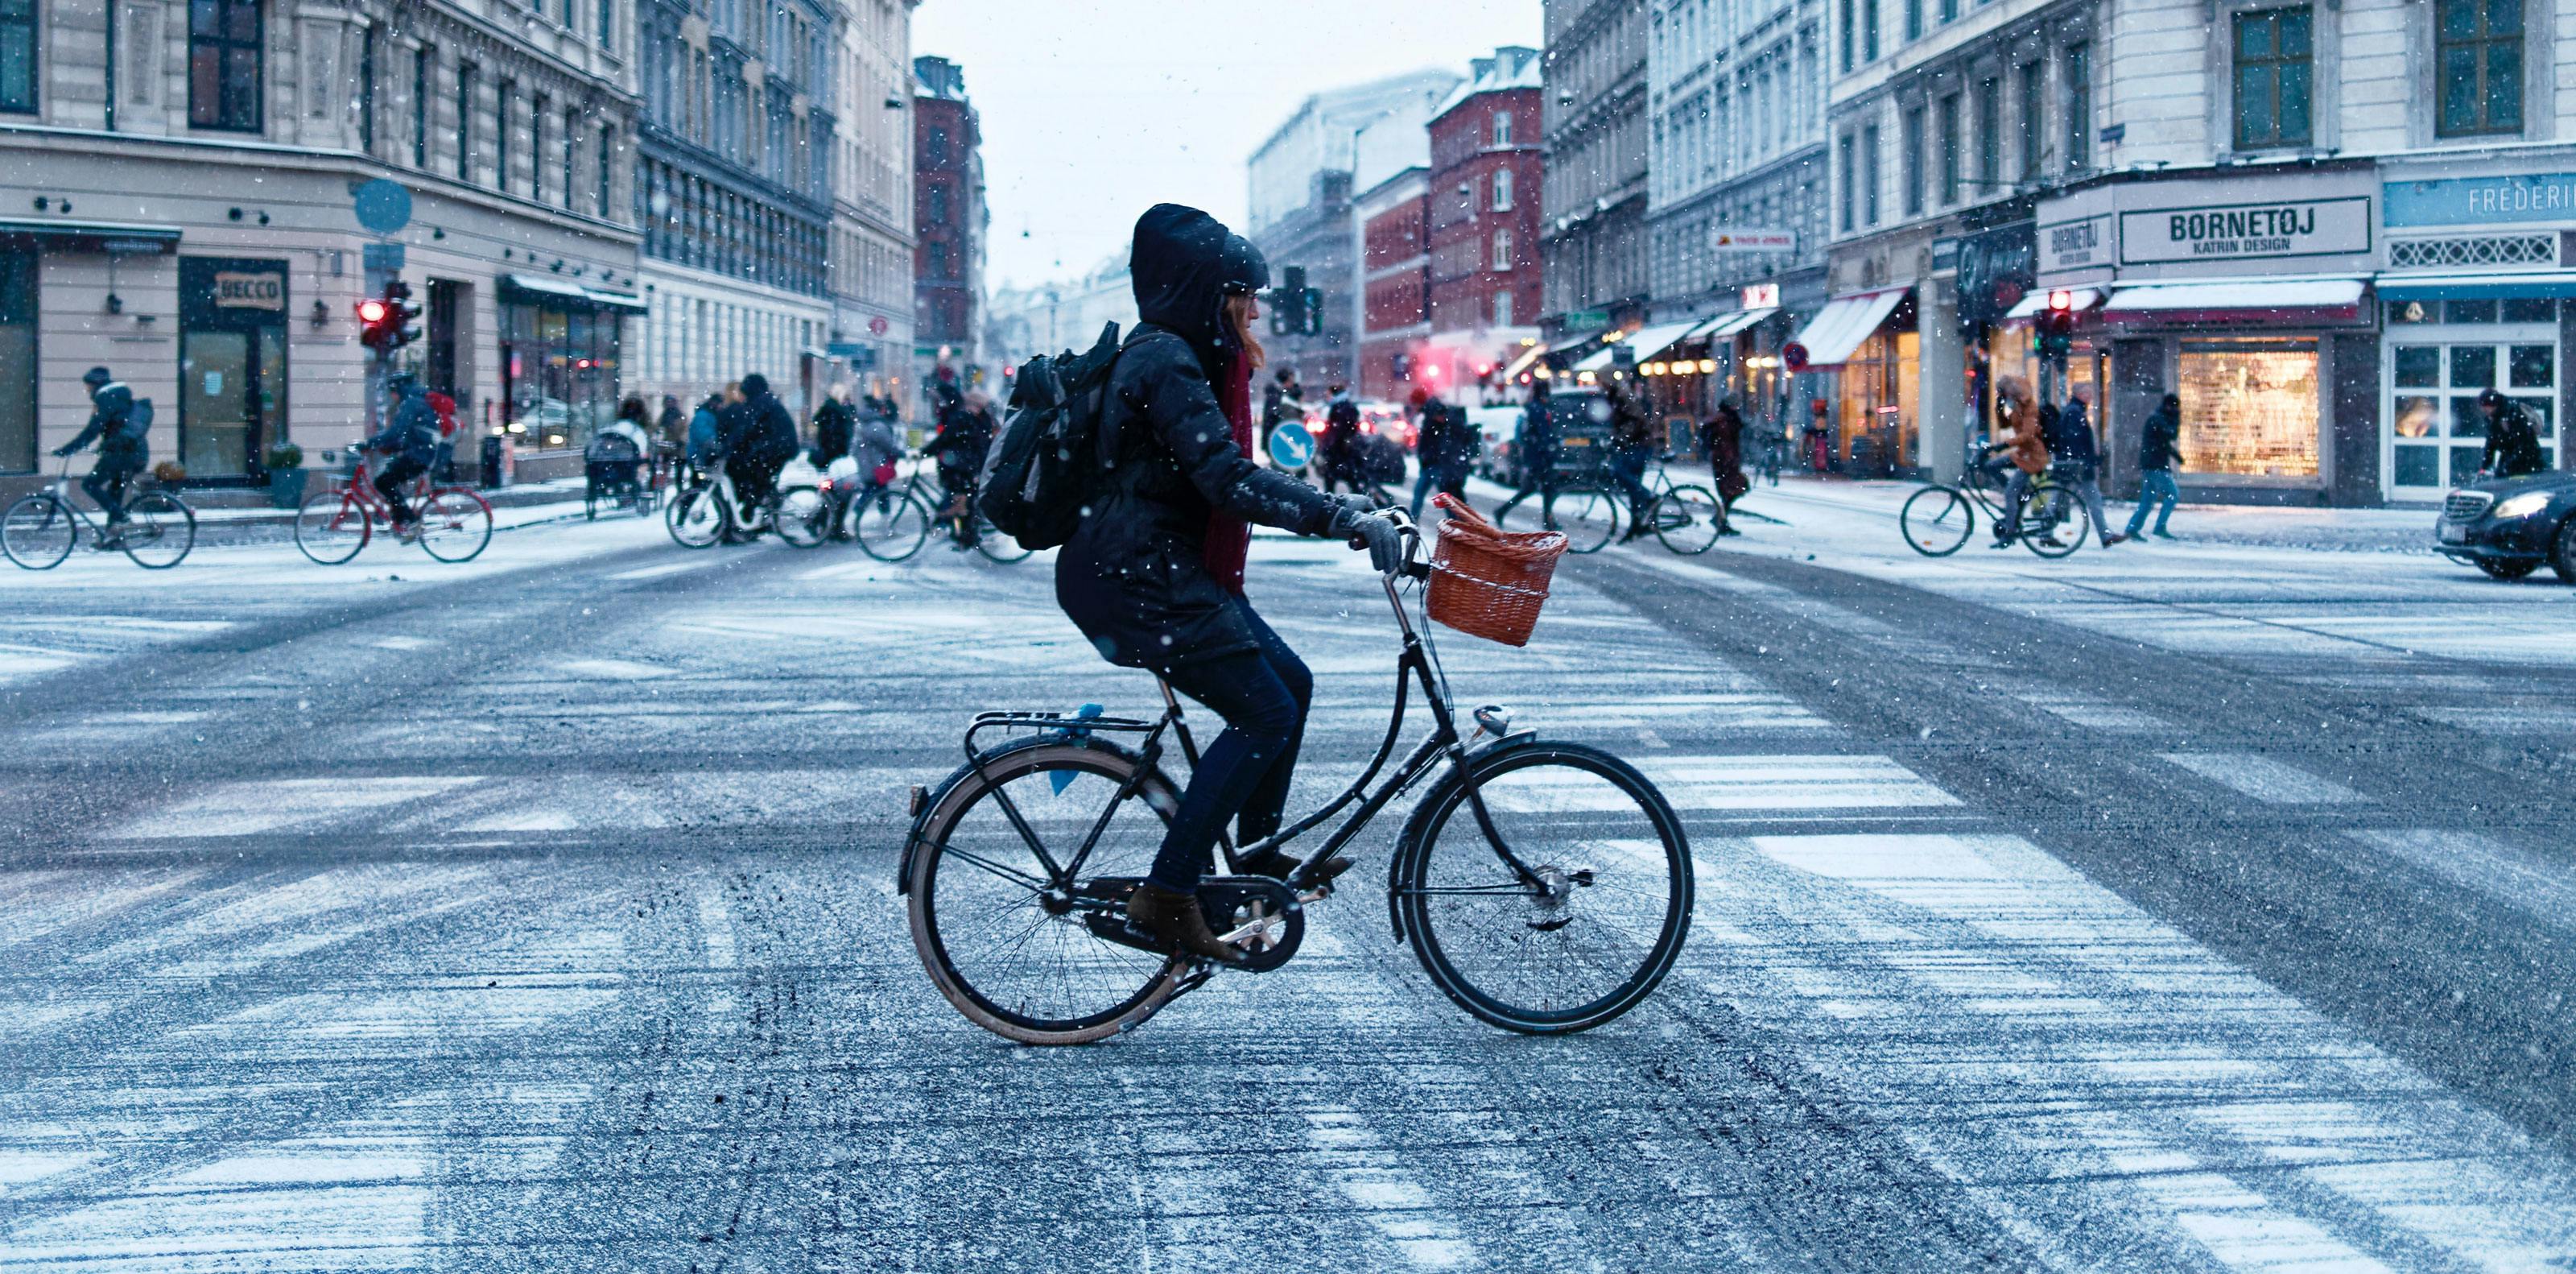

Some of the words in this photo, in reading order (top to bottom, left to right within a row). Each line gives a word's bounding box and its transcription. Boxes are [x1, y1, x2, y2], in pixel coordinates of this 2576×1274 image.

[2469, 184, 2576, 213] FREDERI
[2170, 207, 2315, 242] BØRNETØJ
[2194, 241, 2239, 254] KATRIN
[2244, 238, 2291, 252] DESIGN
[221, 279, 279, 299] BECCO
